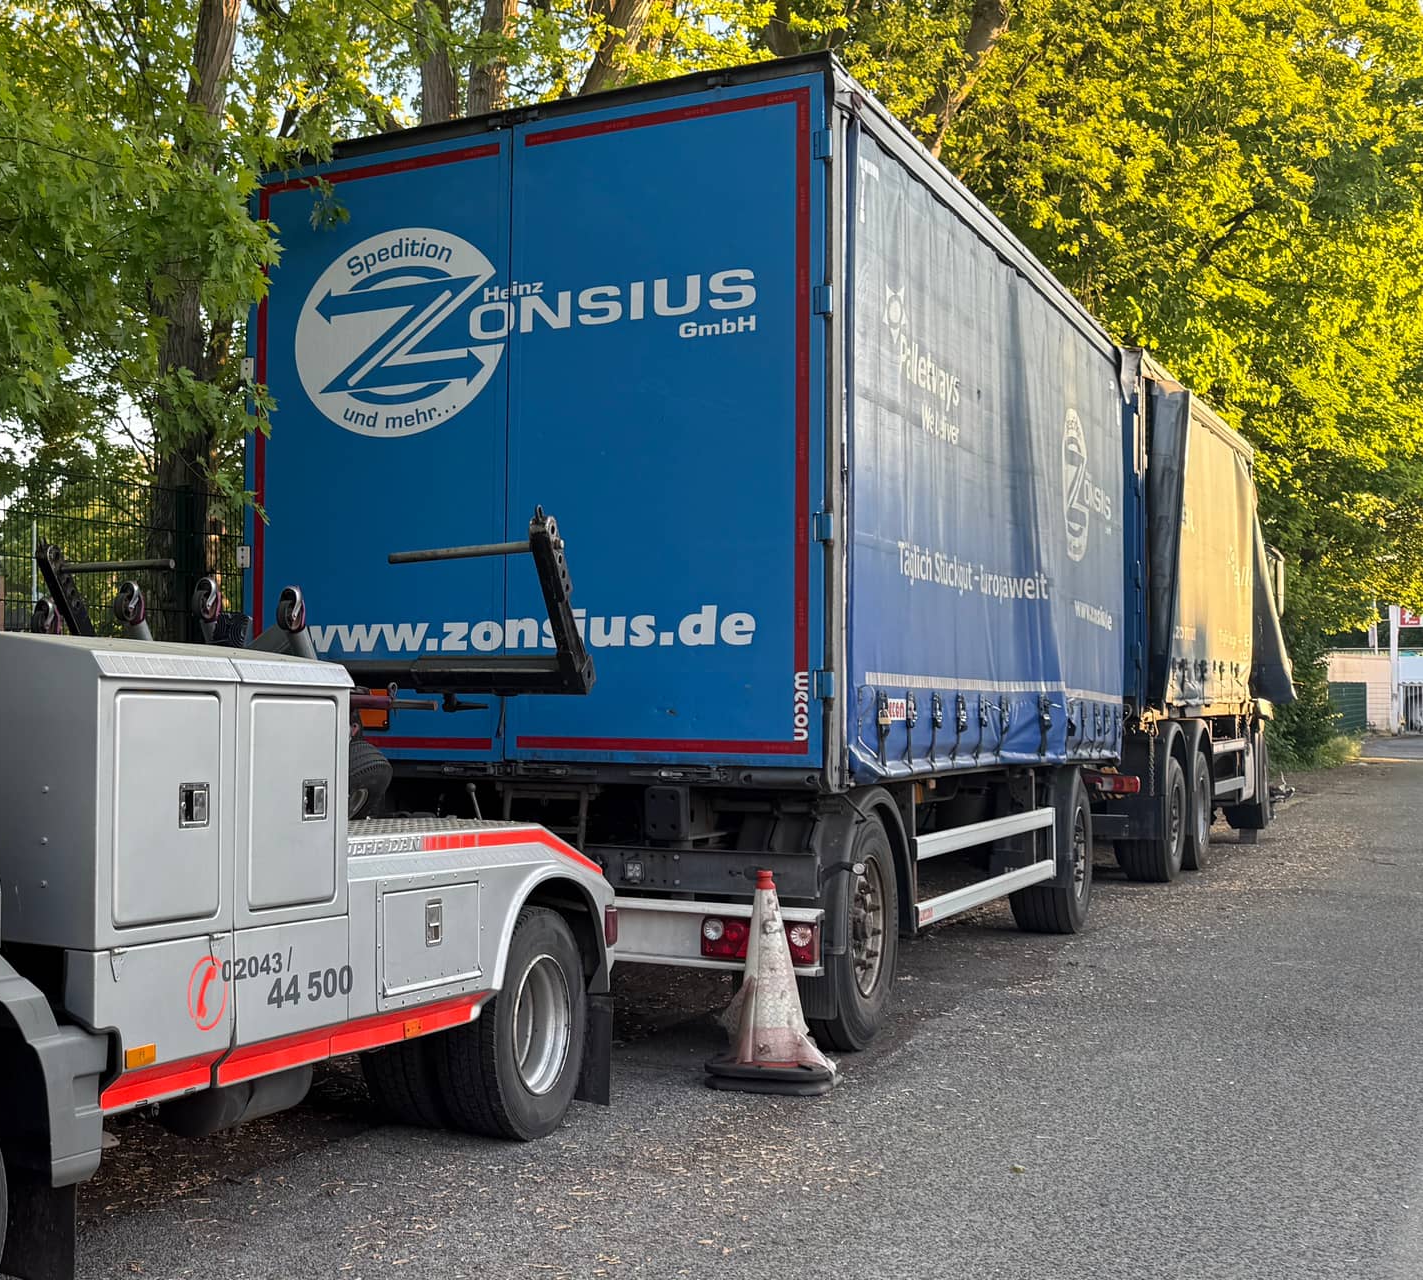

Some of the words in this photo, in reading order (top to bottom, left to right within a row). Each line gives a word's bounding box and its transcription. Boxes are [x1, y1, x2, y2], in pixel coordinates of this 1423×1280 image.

[347, 237, 453, 277] Spedition
[484, 280, 543, 300] Heinz
[679, 315, 756, 339] GmbH
[343, 407, 378, 428] und
[385, 405, 457, 429] mehr...
[898, 541, 932, 585] Täglich
[934, 551, 973, 596] Stückgut
[792, 671, 809, 742] wecon
[222, 952, 283, 982] 02043
[267, 974, 300, 1009] 44
[307, 965, 354, 1001] 500
